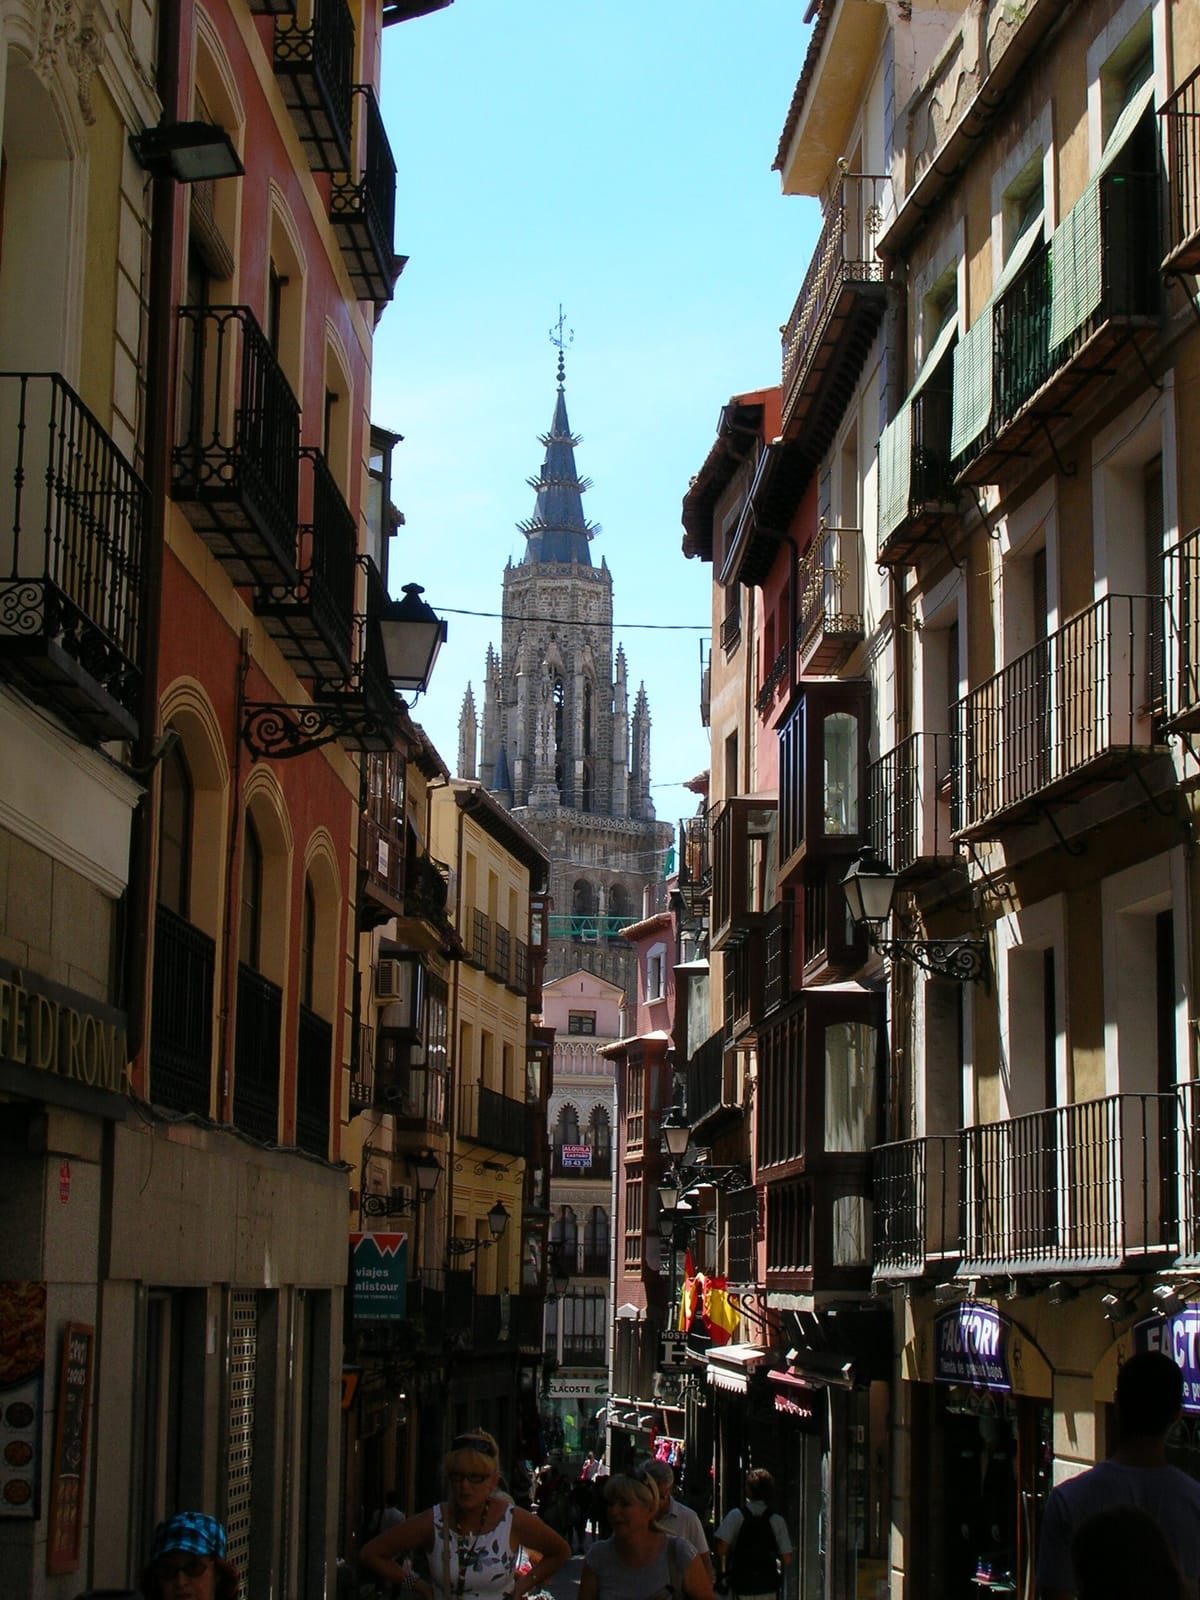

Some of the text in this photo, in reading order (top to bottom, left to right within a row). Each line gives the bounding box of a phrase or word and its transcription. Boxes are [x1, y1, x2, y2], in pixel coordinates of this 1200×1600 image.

[37, 993, 60, 1075] DI
[66, 1007, 130, 1097] ROMA
[355, 1267, 389, 1279] viajes
[941, 1314, 1000, 1356] FACTORY
[1146, 1319, 1200, 1369] FACT
[984, 1361, 1003, 1381] bajos
